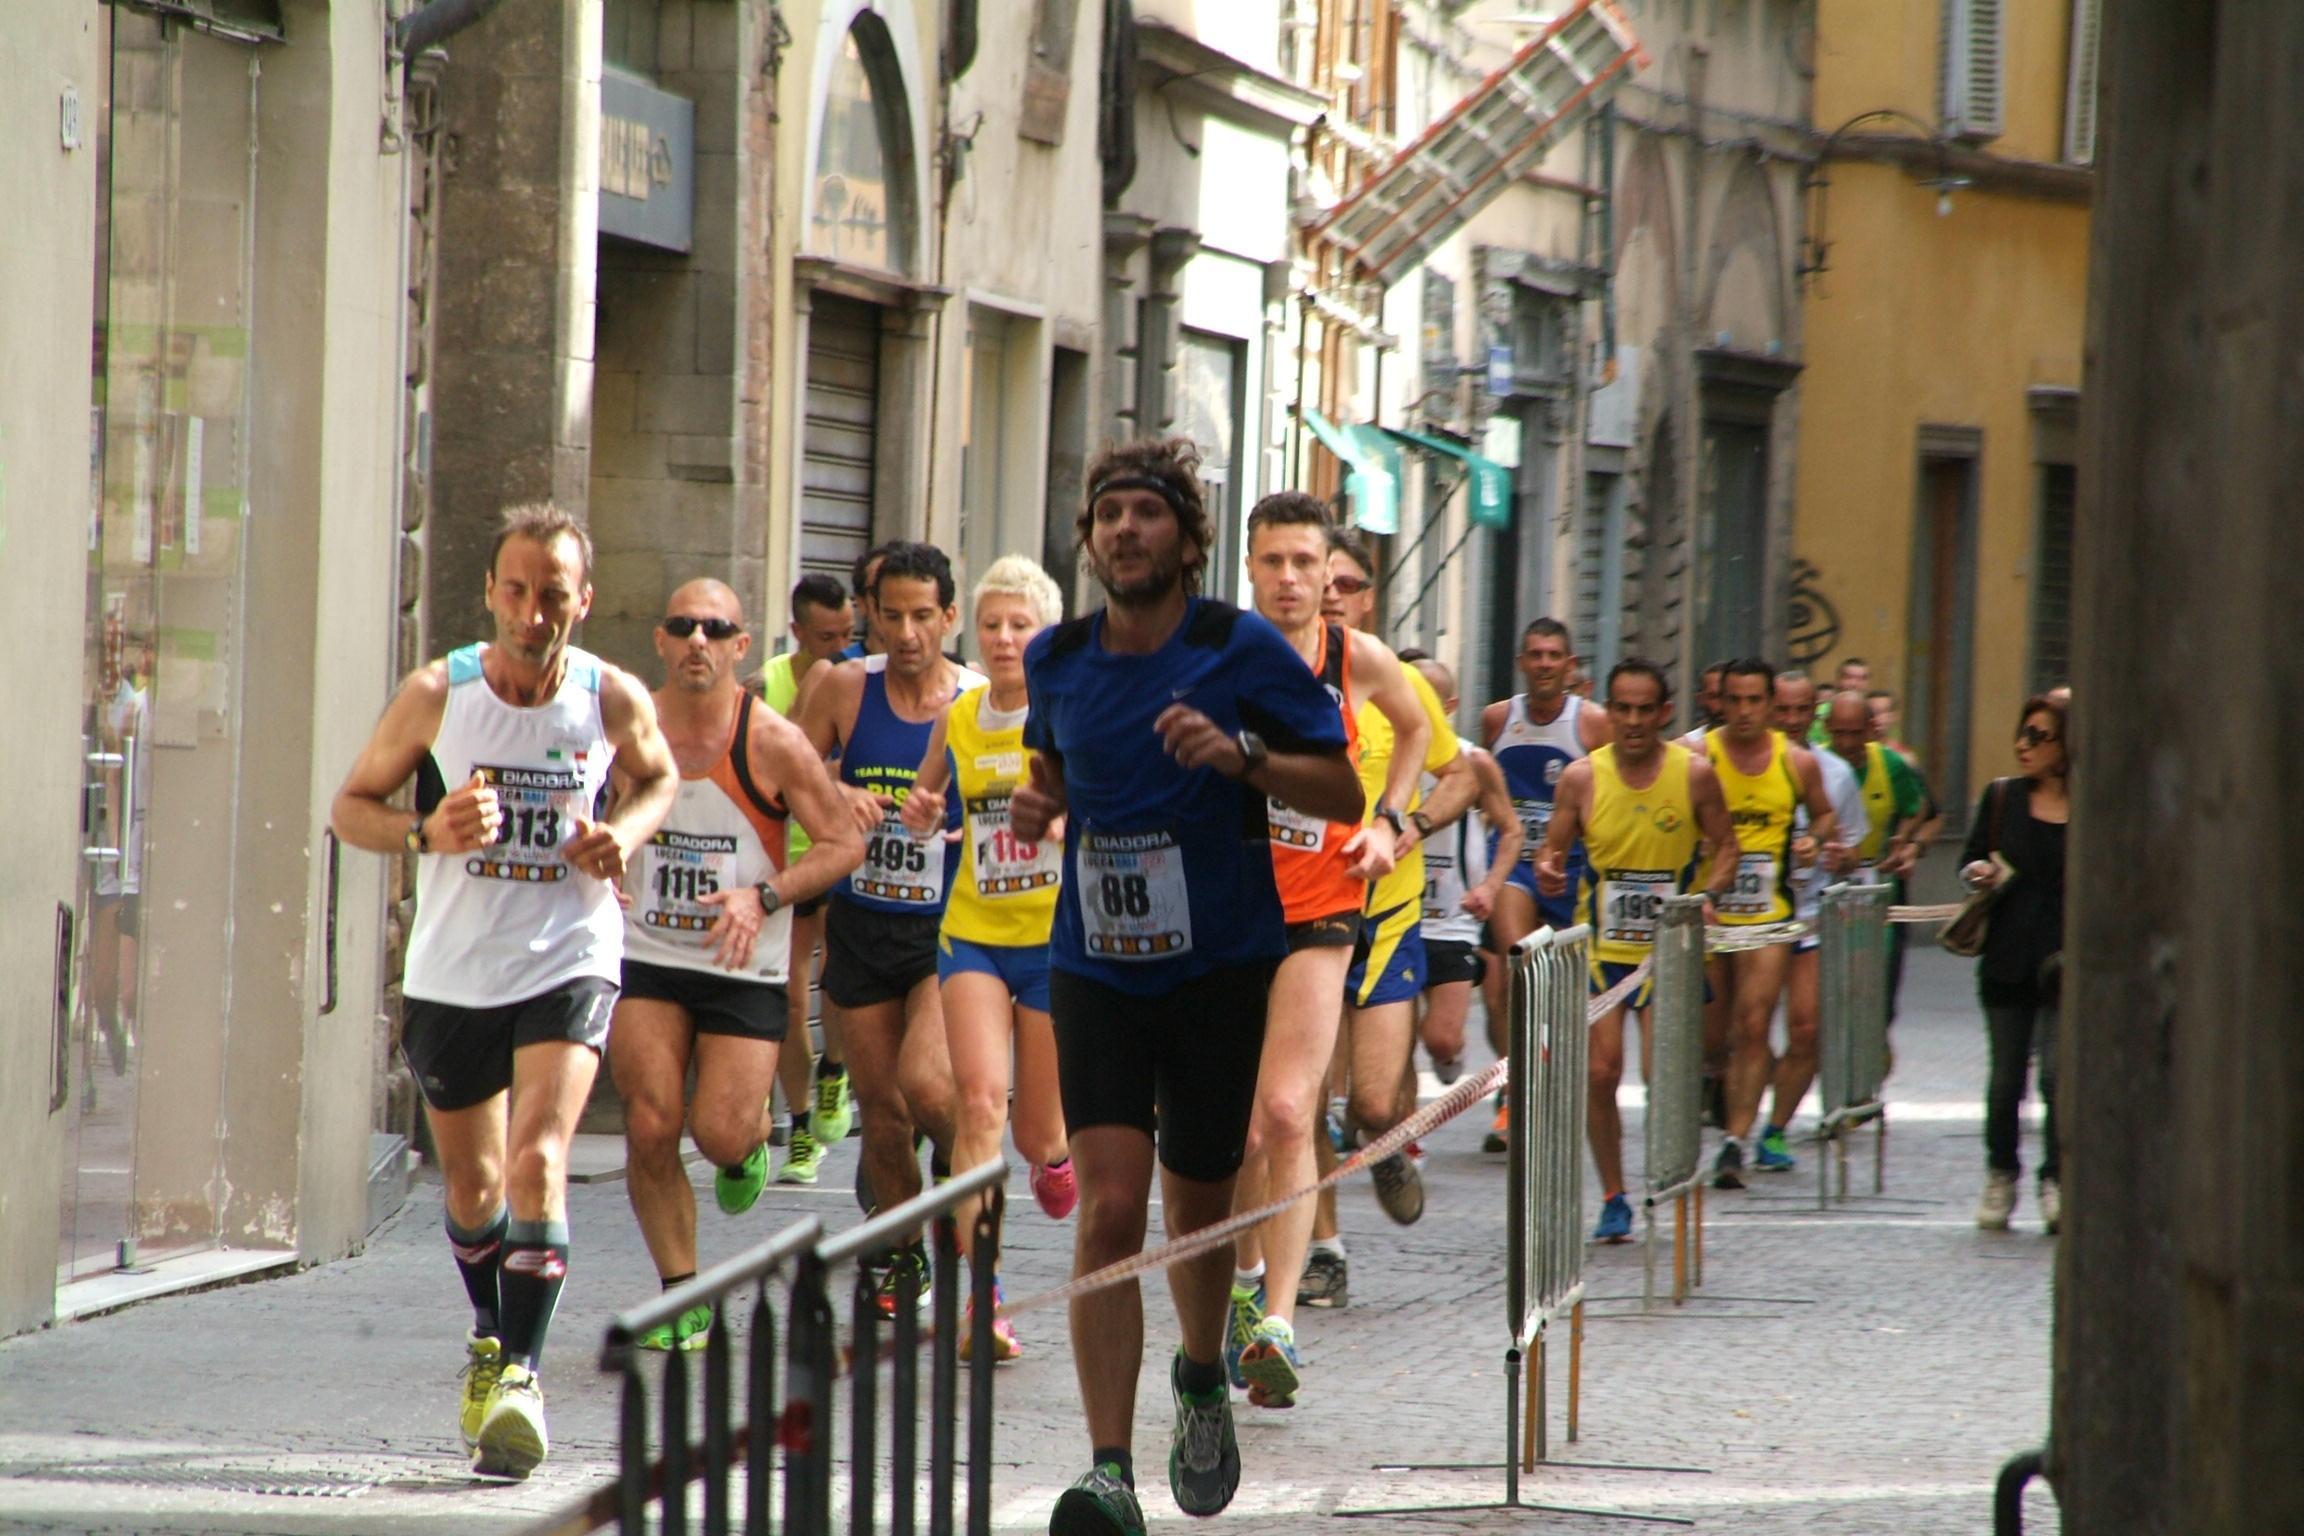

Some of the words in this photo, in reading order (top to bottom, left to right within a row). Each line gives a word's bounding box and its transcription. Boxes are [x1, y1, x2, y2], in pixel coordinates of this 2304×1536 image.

[503, 769, 579, 789] DIADORA
[669, 834, 732, 850] DIADORA
[867, 835, 925, 872] 495
[1094, 831, 1172, 850] DIADORA
[657, 864, 718, 901] 1115
[1102, 873, 1150, 917] 88
